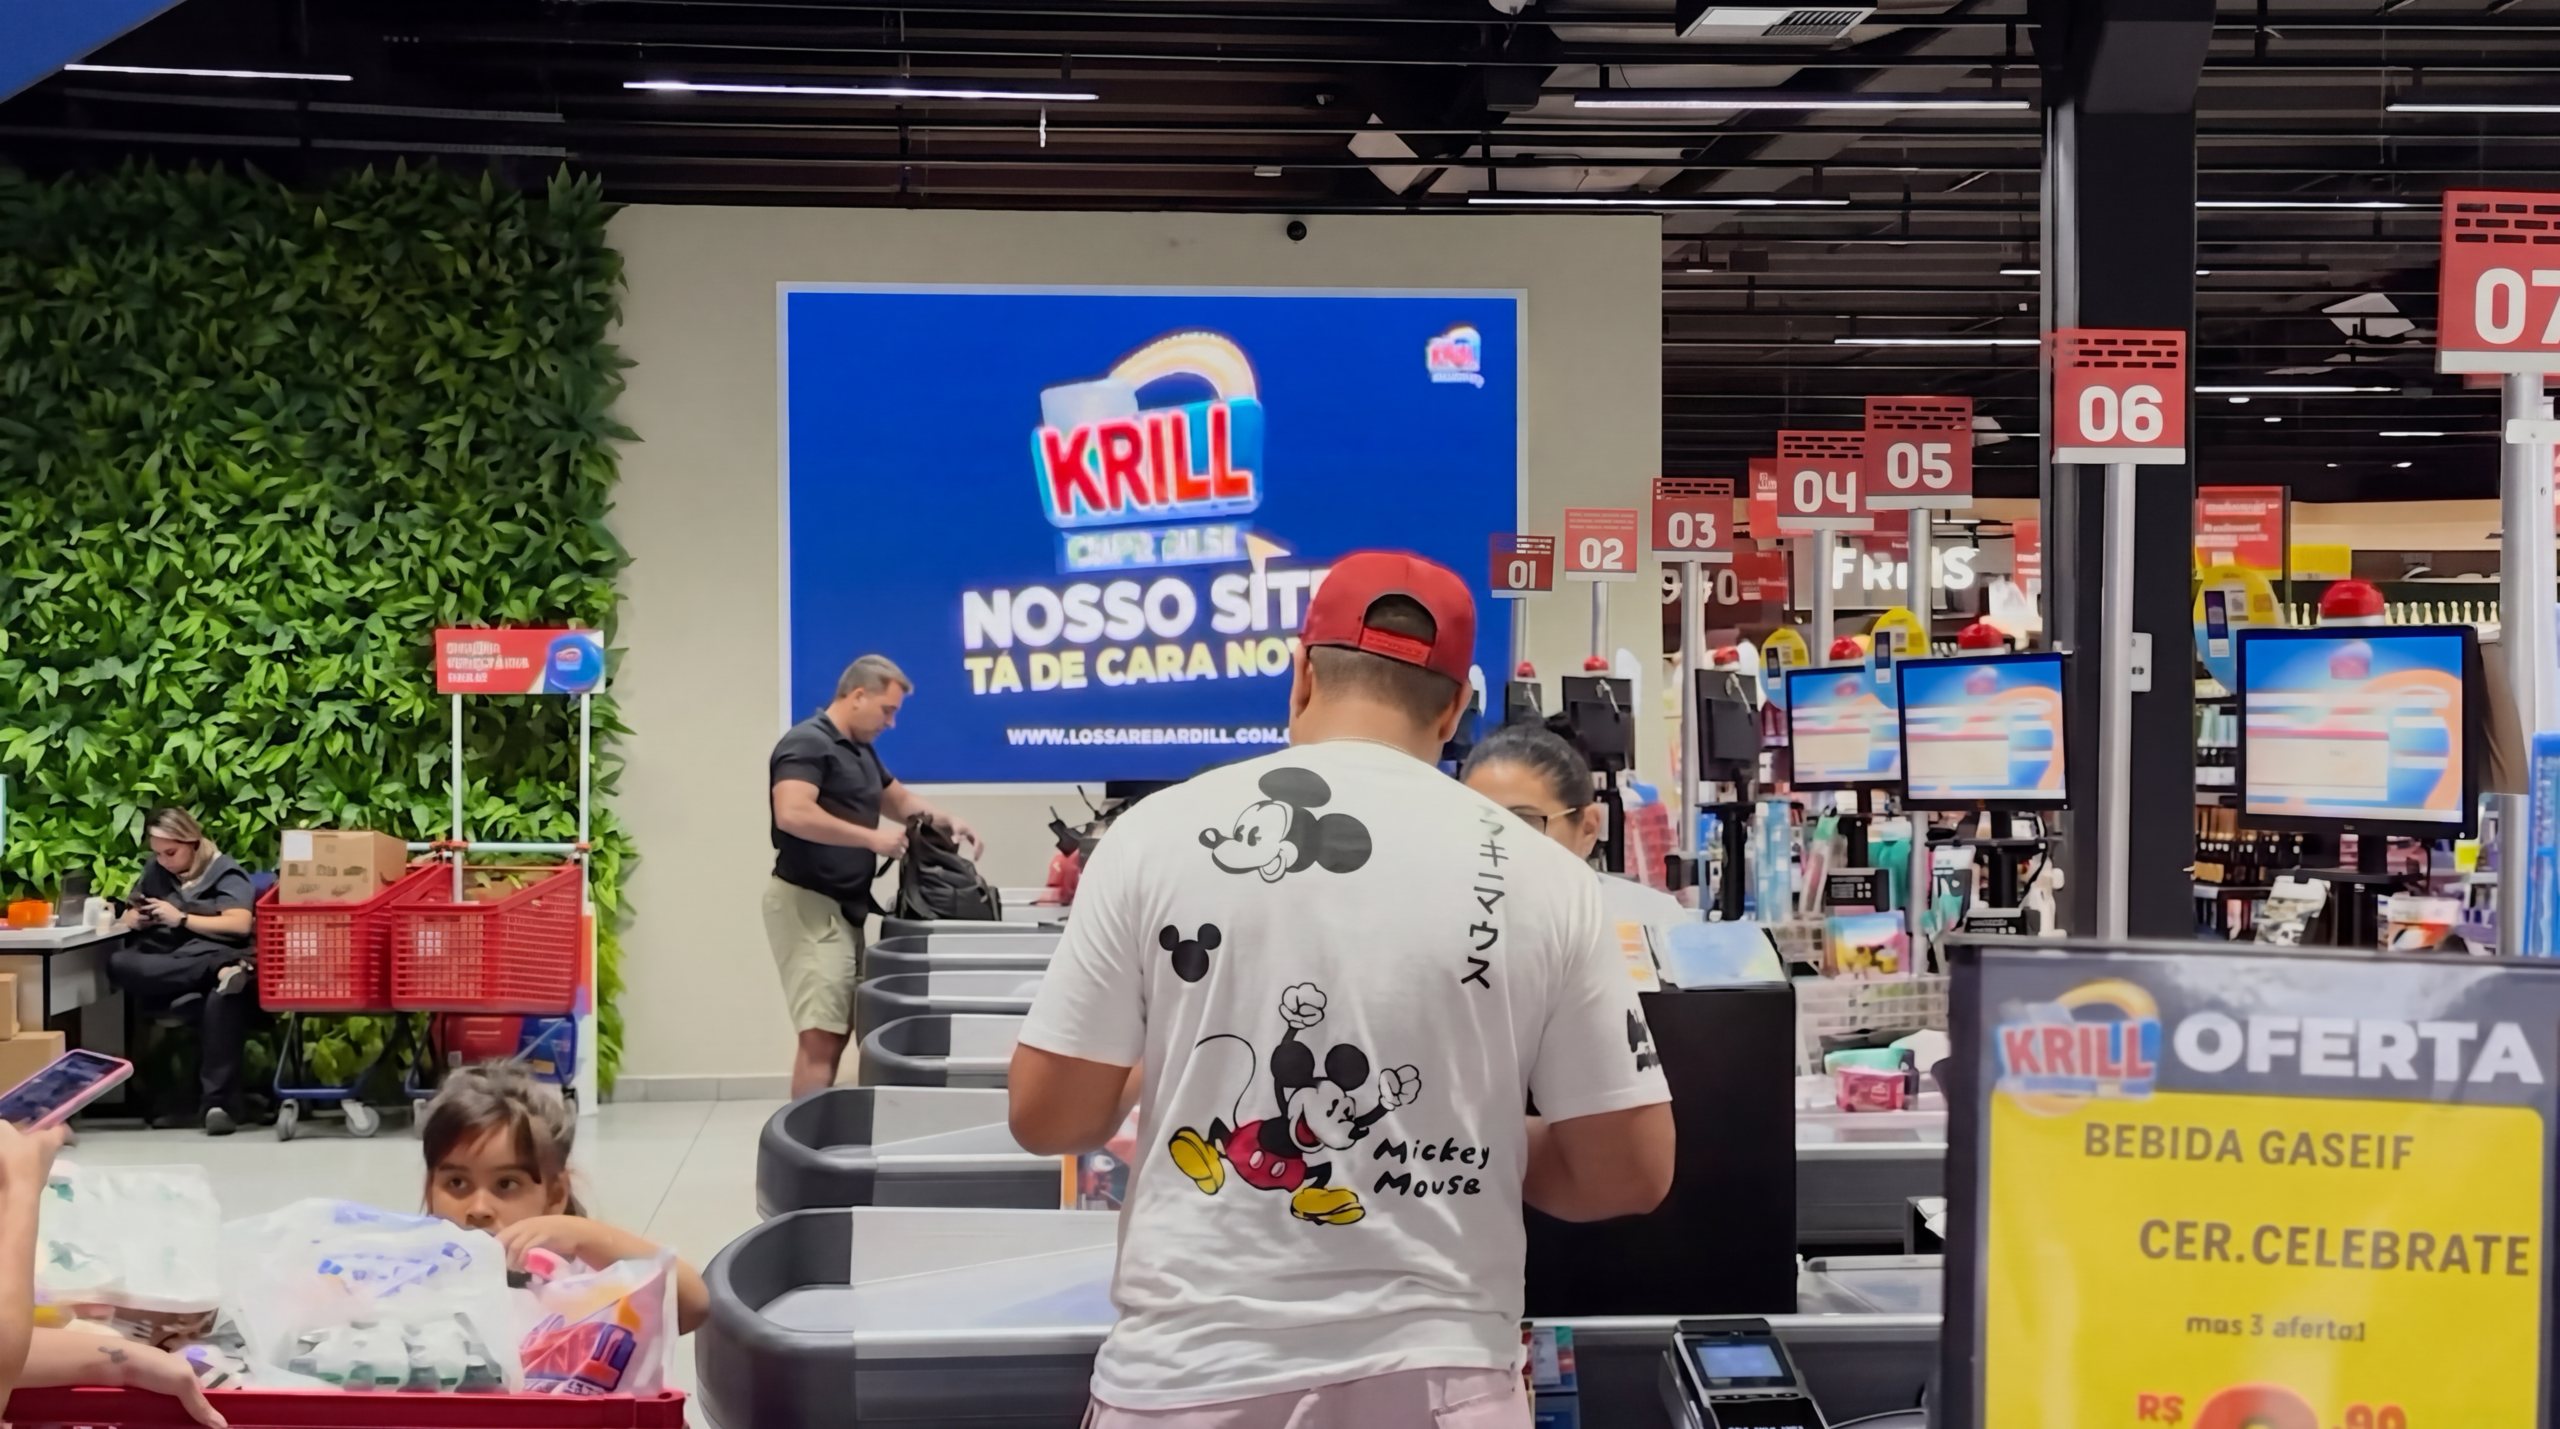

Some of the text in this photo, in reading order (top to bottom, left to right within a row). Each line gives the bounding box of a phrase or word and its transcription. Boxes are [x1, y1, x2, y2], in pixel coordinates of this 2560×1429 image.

[2475, 267, 2560, 345] 07
[2079, 384, 2163, 443] 06
[1040, 402, 1254, 516] KRILL
[1886, 442, 1953, 489] 05
[1793, 470, 1857, 513] 04
[1579, 537, 1624, 570] 02
[1668, 512, 1717, 549] 03
[1508, 560, 1537, 589] 01
[963, 568, 1331, 650] NOSSO SIT
[964, 649, 1024, 695] TÁ
[1029, 650, 1087, 692] DE
[1096, 642, 1218, 687] CARA
[2004, 1012, 2544, 1084] KRILL OFERTA
[1373, 1137, 1490, 1170] Mickey
[2085, 1122, 2414, 1170] BEBIDA GASEIF
[1373, 1170, 1481, 1198] Mouse
[2140, 1219, 2530, 1277] CER.CELEBRATE
[2250, 1313, 2263, 1336] 3
